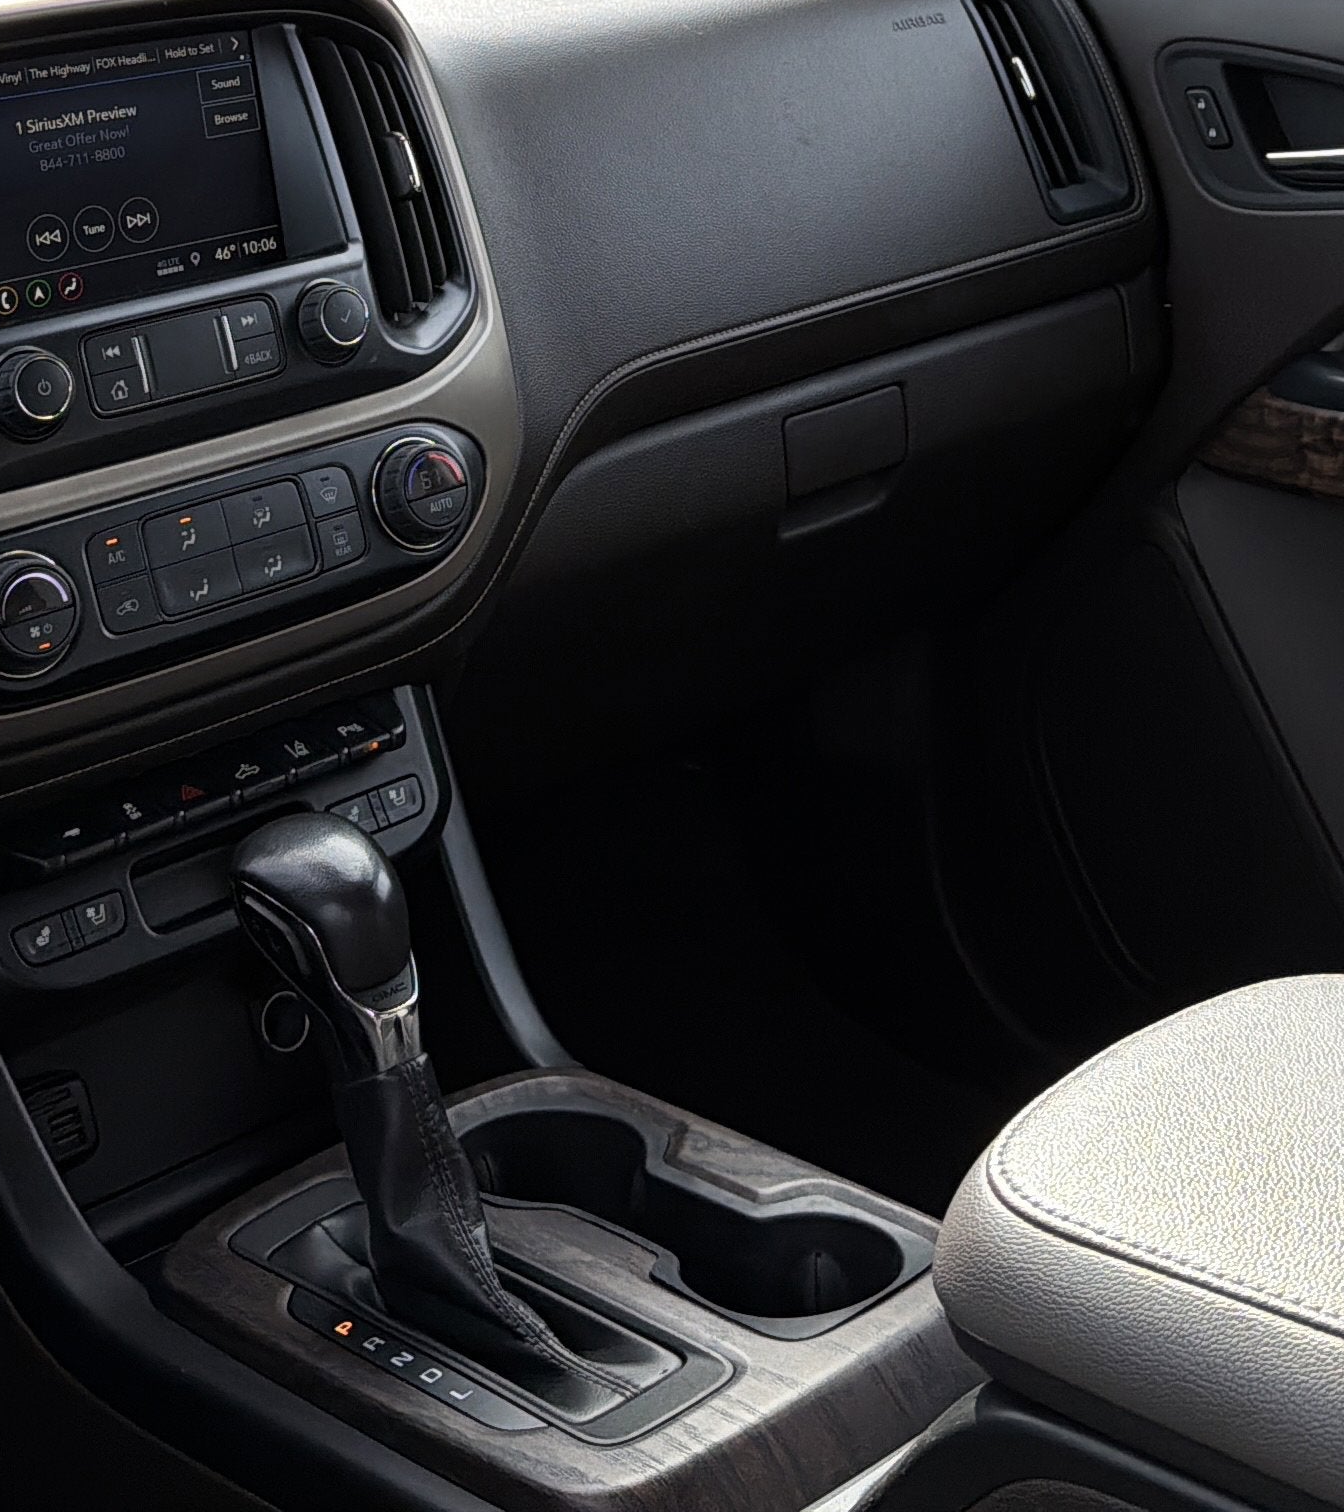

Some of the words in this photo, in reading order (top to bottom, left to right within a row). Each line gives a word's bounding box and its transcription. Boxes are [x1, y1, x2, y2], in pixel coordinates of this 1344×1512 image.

[892, 12, 946, 32] AIRBAG
[164, 47, 188, 60] Hold
[188, 46, 198, 56] to
[199, 43, 216, 55] Set
[28, 67, 49, 80] The
[49, 61, 91, 79] Highway
[95, 57, 117, 70] FOX
[211, 76, 241, 90] Sound
[15, 121, 23, 136] 1
[25, 113, 85, 135] SiriusXM
[86, 105, 137, 124] Preview
[214, 111, 249, 126] Browse
[28, 137, 64, 154] Great
[65, 132, 97, 148] Offer
[99, 124, 130, 141] Now!
[39, 145, 126, 172] 844-711-8800
[82, 224, 106, 236] Tune
[242, 235, 277, 256] 10:06
[167, 256, 181, 267] LTE
[248, 349, 273, 365] BACK
[429, 496, 454, 514] AUTO
[108, 549, 126, 565] A/C
[334, 544, 353, 557] REAR
[371, 982, 408, 1002] GMC
[334, 1321, 353, 1336] P
[362, 1336, 386, 1352] R
[389, 1351, 414, 1367] N
[419, 1367, 443, 1384] D
[449, 1387, 473, 1400] L
